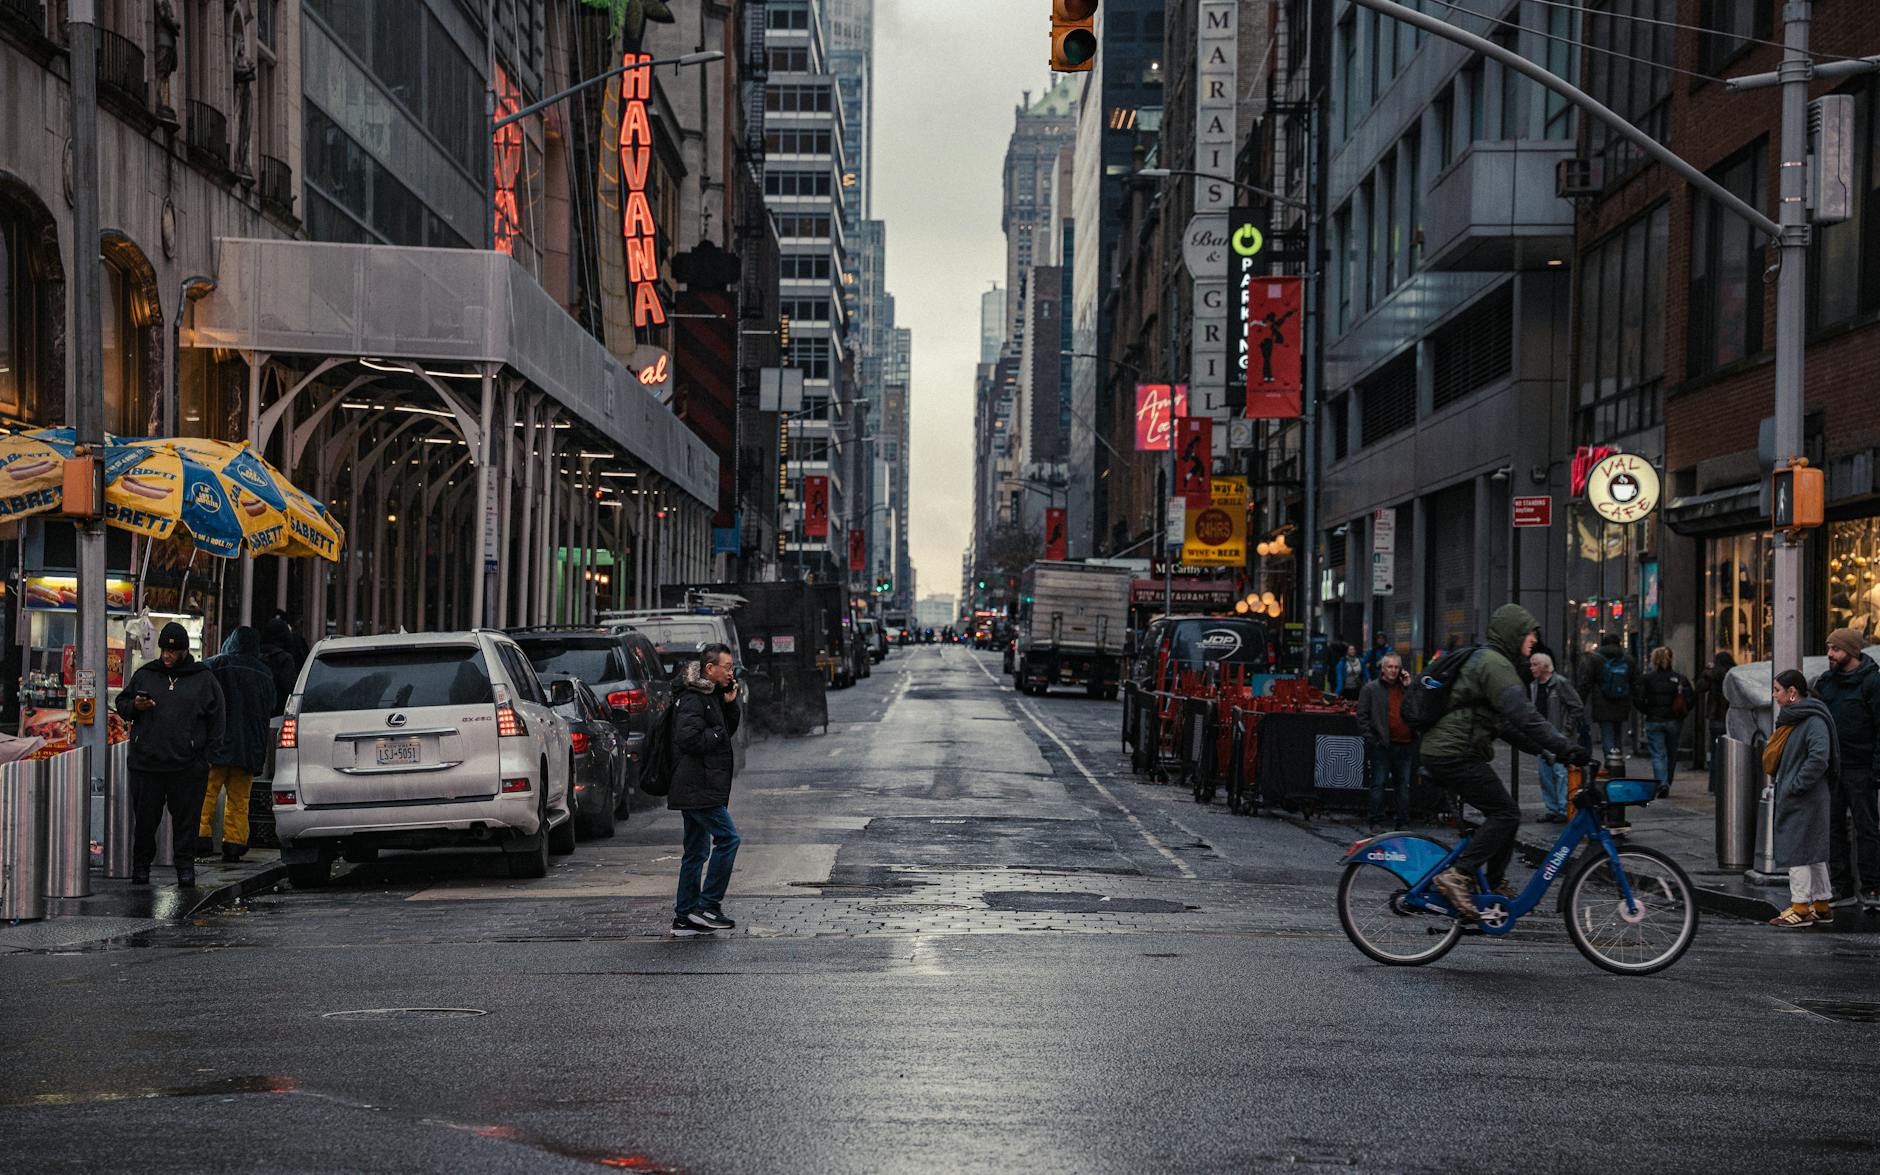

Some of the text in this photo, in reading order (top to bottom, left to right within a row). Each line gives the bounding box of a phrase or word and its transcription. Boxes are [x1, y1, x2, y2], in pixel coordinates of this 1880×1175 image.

[1206, 10, 1230, 203] MARAIS
[620, 53, 666, 328] HAVANA
[1602, 457, 1641, 478] VAL
[1599, 498, 1651, 521] CAFE
[290, 516, 335, 554] SABRETT
[1199, 519, 1231, 538] 24HRS
[1187, 548, 1240, 557] WINE BEER
[1155, 592, 1209, 601] RETAURANT
[1367, 850, 1407, 861] citi bike
[1554, 846, 1570, 866] bike
